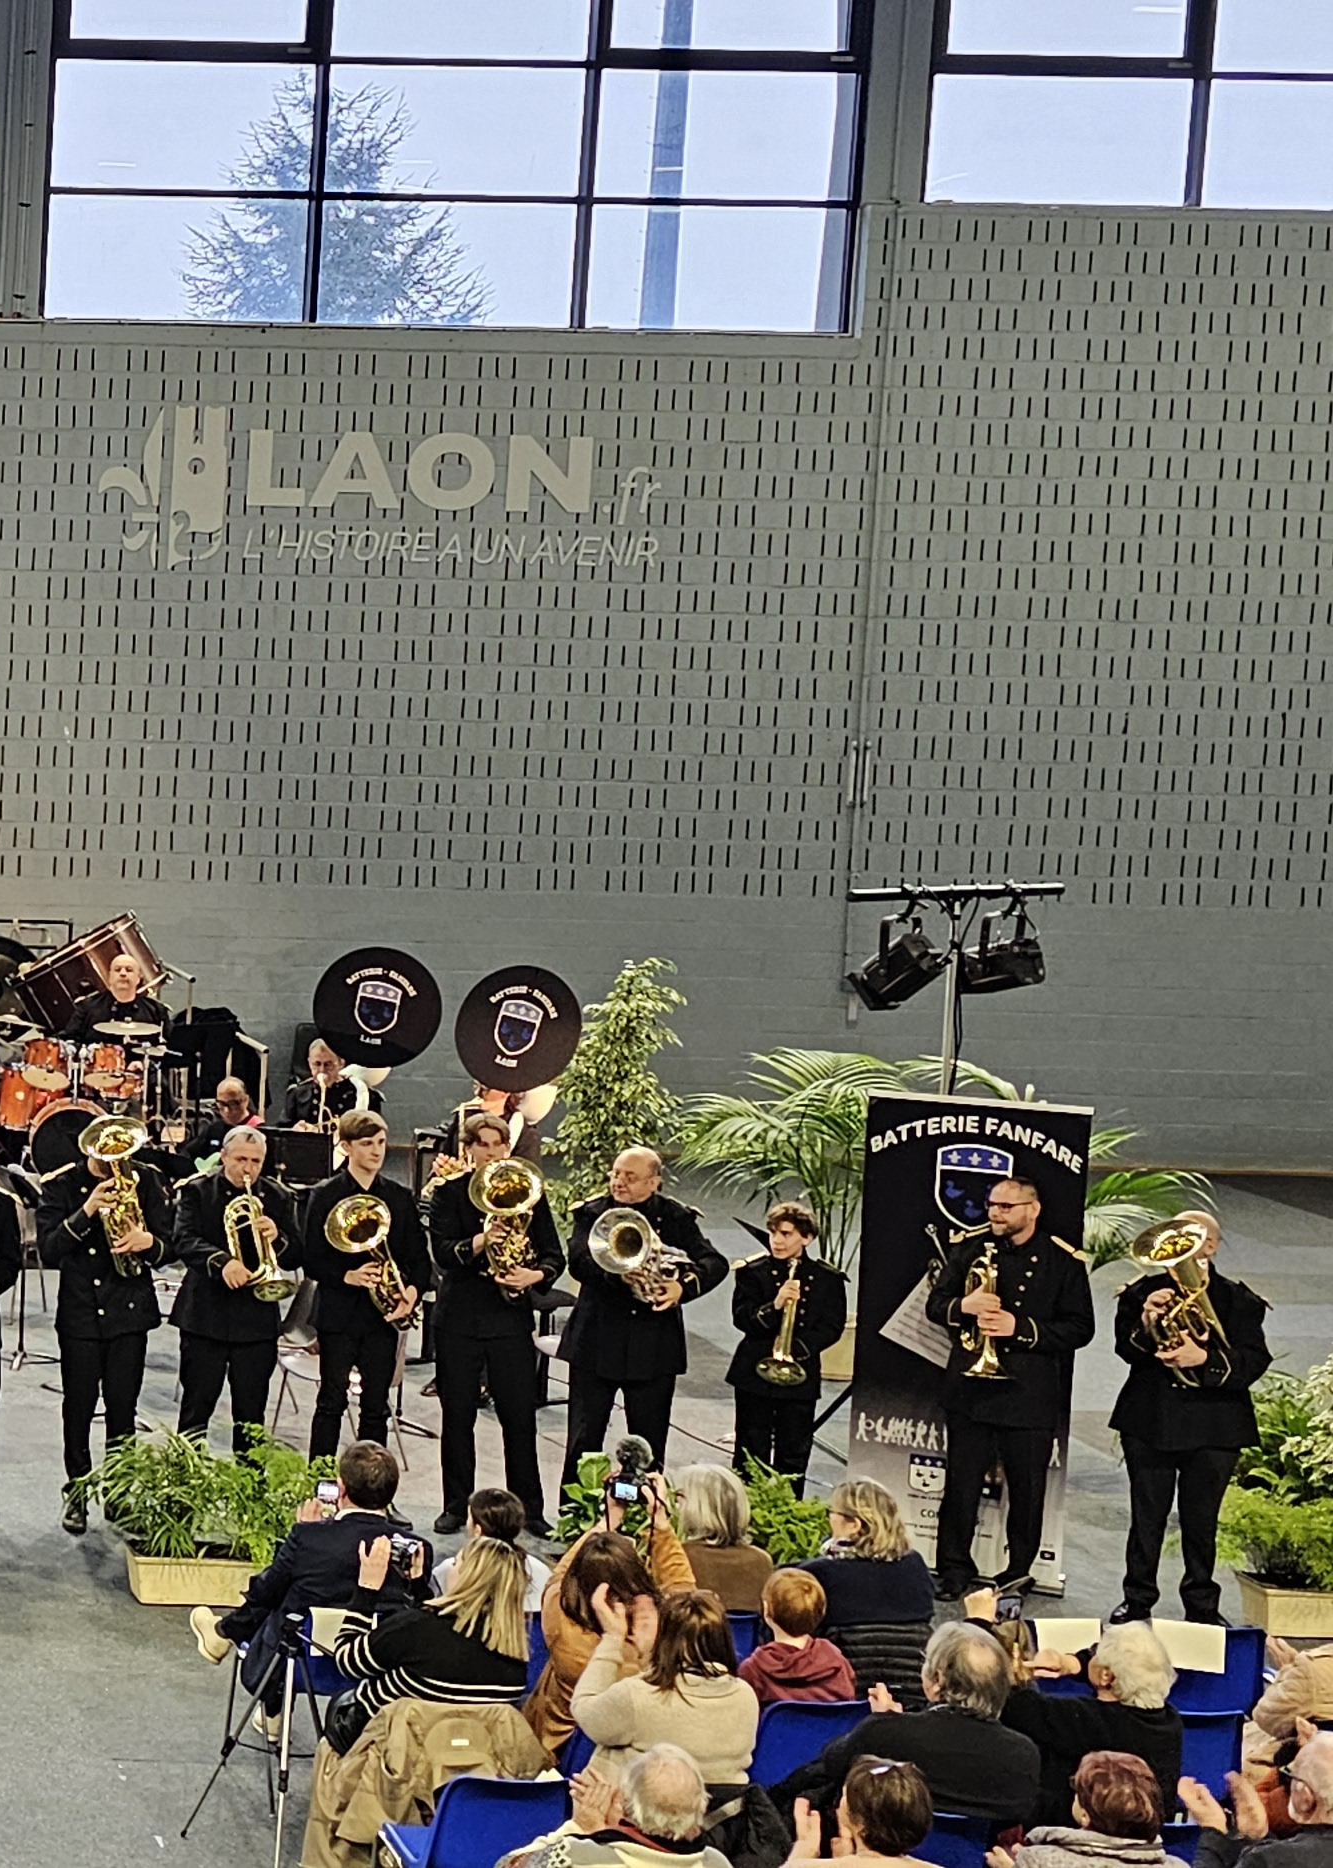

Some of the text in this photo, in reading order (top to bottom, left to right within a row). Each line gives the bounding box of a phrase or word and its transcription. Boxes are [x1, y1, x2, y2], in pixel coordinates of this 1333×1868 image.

[242, 528, 660, 568] L'HISTOIRE A UN AVENIR
[870, 1115, 1083, 1174] BATTERIE FANFARE
